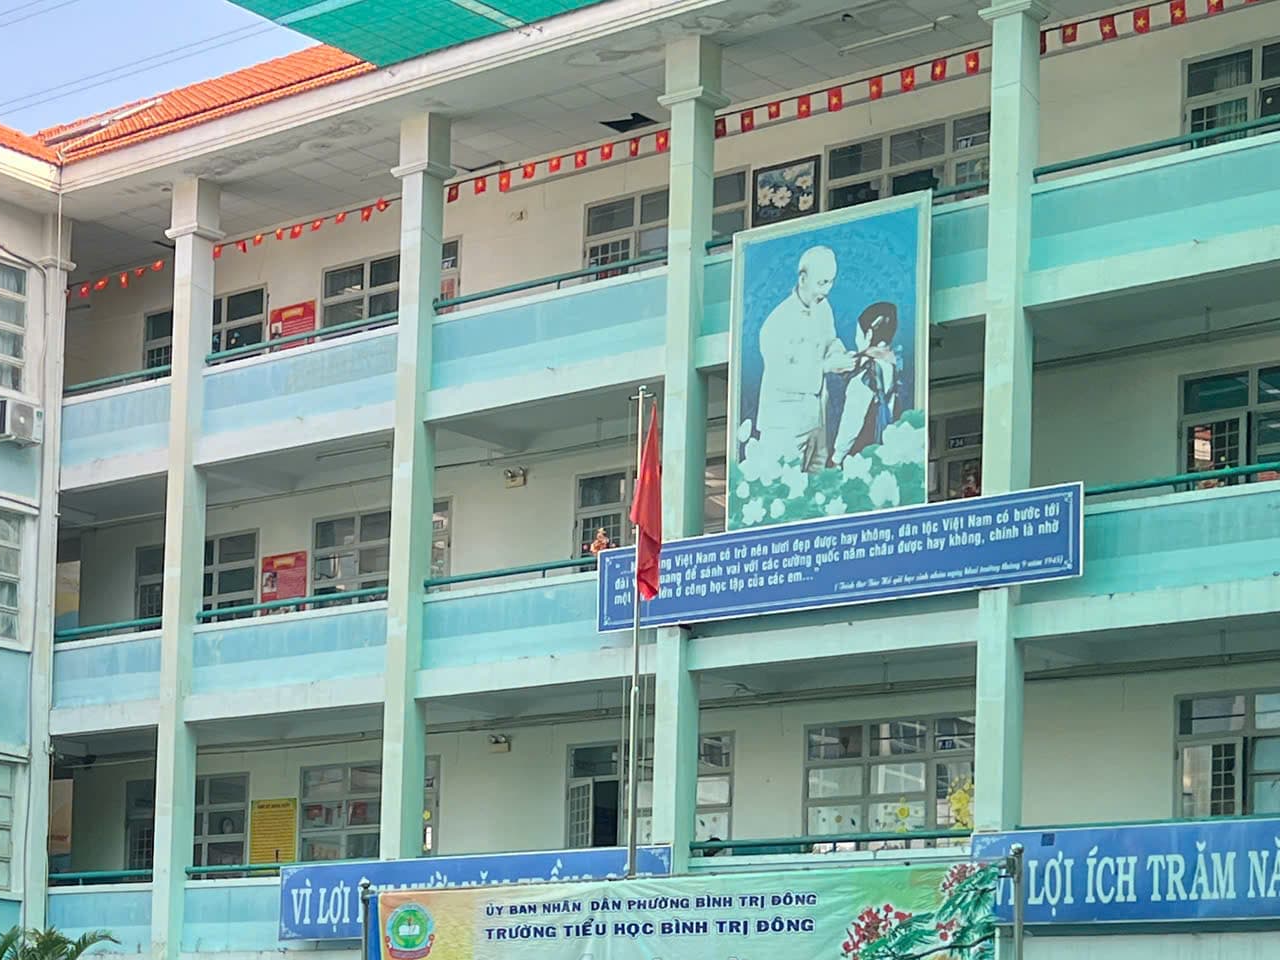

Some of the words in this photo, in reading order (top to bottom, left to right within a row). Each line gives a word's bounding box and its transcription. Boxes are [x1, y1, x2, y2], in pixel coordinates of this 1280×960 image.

[675, 553, 693, 569] Việt
[696, 552, 717, 566] Nam
[720, 550, 732, 562] có
[750, 546, 768, 558] nên
[840, 532, 858, 546] hay
[861, 527, 894, 543] không,
[922, 520, 938, 537] tộc
[942, 516, 964, 532] Việt
[968, 514, 992, 528] Nam
[996, 509, 1010, 524] có
[1014, 504, 1041, 522] bước
[700, 564, 723, 579] sánh
[726, 563, 741, 576] vai
[744, 559, 759, 574] với
[762, 557, 779, 571] các
[898, 540, 923, 556] được
[926, 536, 945, 551] hay
[948, 531, 985, 548] không,
[990, 526, 1019, 542] chính
[685, 580, 706, 598] công
[710, 578, 726, 594] học
[729, 574, 745, 592] tập
[768, 572, 785, 586] các
[292, 878, 312, 925] VÌ
[318, 879, 351, 933] LỢI
[486, 902, 504, 916] ỦY
[509, 904, 537, 915] BAN
[542, 899, 582, 914] NHÂN
[590, 898, 622, 912] DÂN
[628, 896, 690, 910] PHƯỜNG
[696, 894, 732, 908] BÌNH
[738, 896, 765, 910] TRỊ
[771, 892, 817, 906] ĐÔNG
[1028, 850, 1074, 917] LỢI
[1085, 845, 1138, 904] ÍCH
[1146, 841, 1236, 902] TRĂM
[486, 924, 557, 940] TRƯỜNG
[564, 918, 607, 938] TIỂU
[614, 923, 654, 940] HỌC
[660, 918, 708, 935] BÌNH
[716, 920, 748, 936] TRỊ
[756, 918, 814, 934] ĐÔNG
